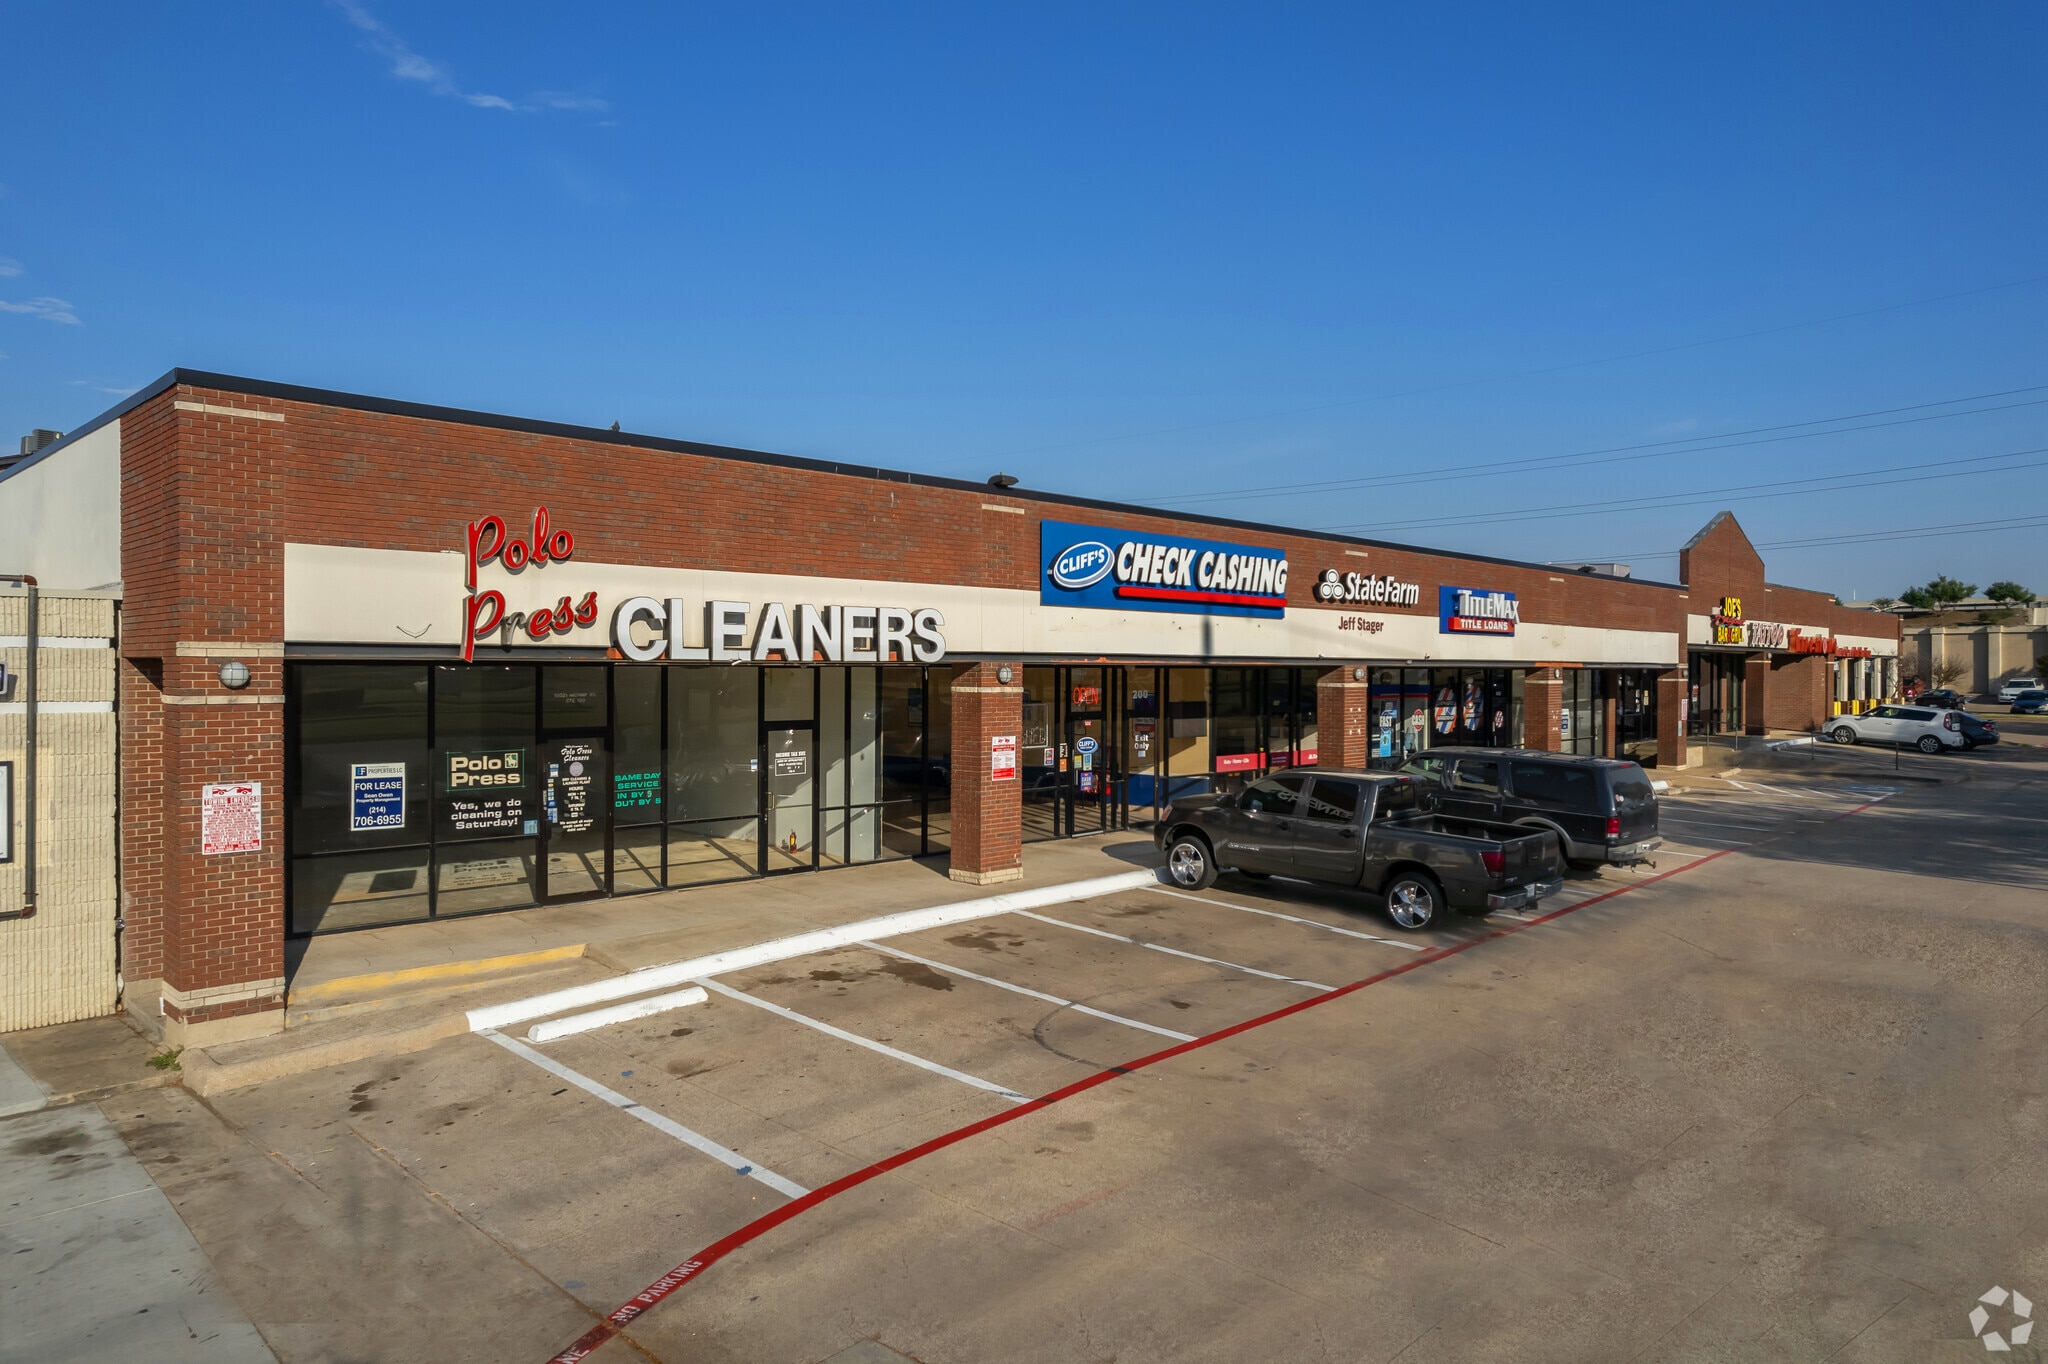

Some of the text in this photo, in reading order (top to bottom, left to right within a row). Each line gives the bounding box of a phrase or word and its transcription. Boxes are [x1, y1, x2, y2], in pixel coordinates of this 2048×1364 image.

[466, 506, 574, 588] Polo
[1059, 548, 1105, 575] CLIFF'S
[1117, 541, 1288, 595] CHECK CASHING
[460, 589, 598, 662] Press
[613, 596, 946, 662] CLEANERS
[1338, 616, 1384, 634] Jeff Stager
[1460, 618, 1509, 631] TITLE LOANS
[1073, 687, 1099, 705] OPEN
[1132, 690, 1148, 699] 200
[1135, 734, 1149, 742] Exit
[1134, 742, 1149, 750] Only
[451, 755, 502, 772] Polo
[451, 772, 521, 787] Press
[615, 773, 642, 781] SAME
[355, 781, 402, 790] FOR LEASE
[617, 781, 659, 789] SERVICE
[452, 802, 478, 810] Yes,
[506, 798, 521, 807] do
[638, 798, 651, 806] BY
[368, 806, 386, 814] (214)
[451, 810, 502, 820] cleaning
[354, 814, 401, 827] 706-6955
[455, 817, 518, 829] Saturday!
[612, 1260, 703, 1322] NO PARKING
